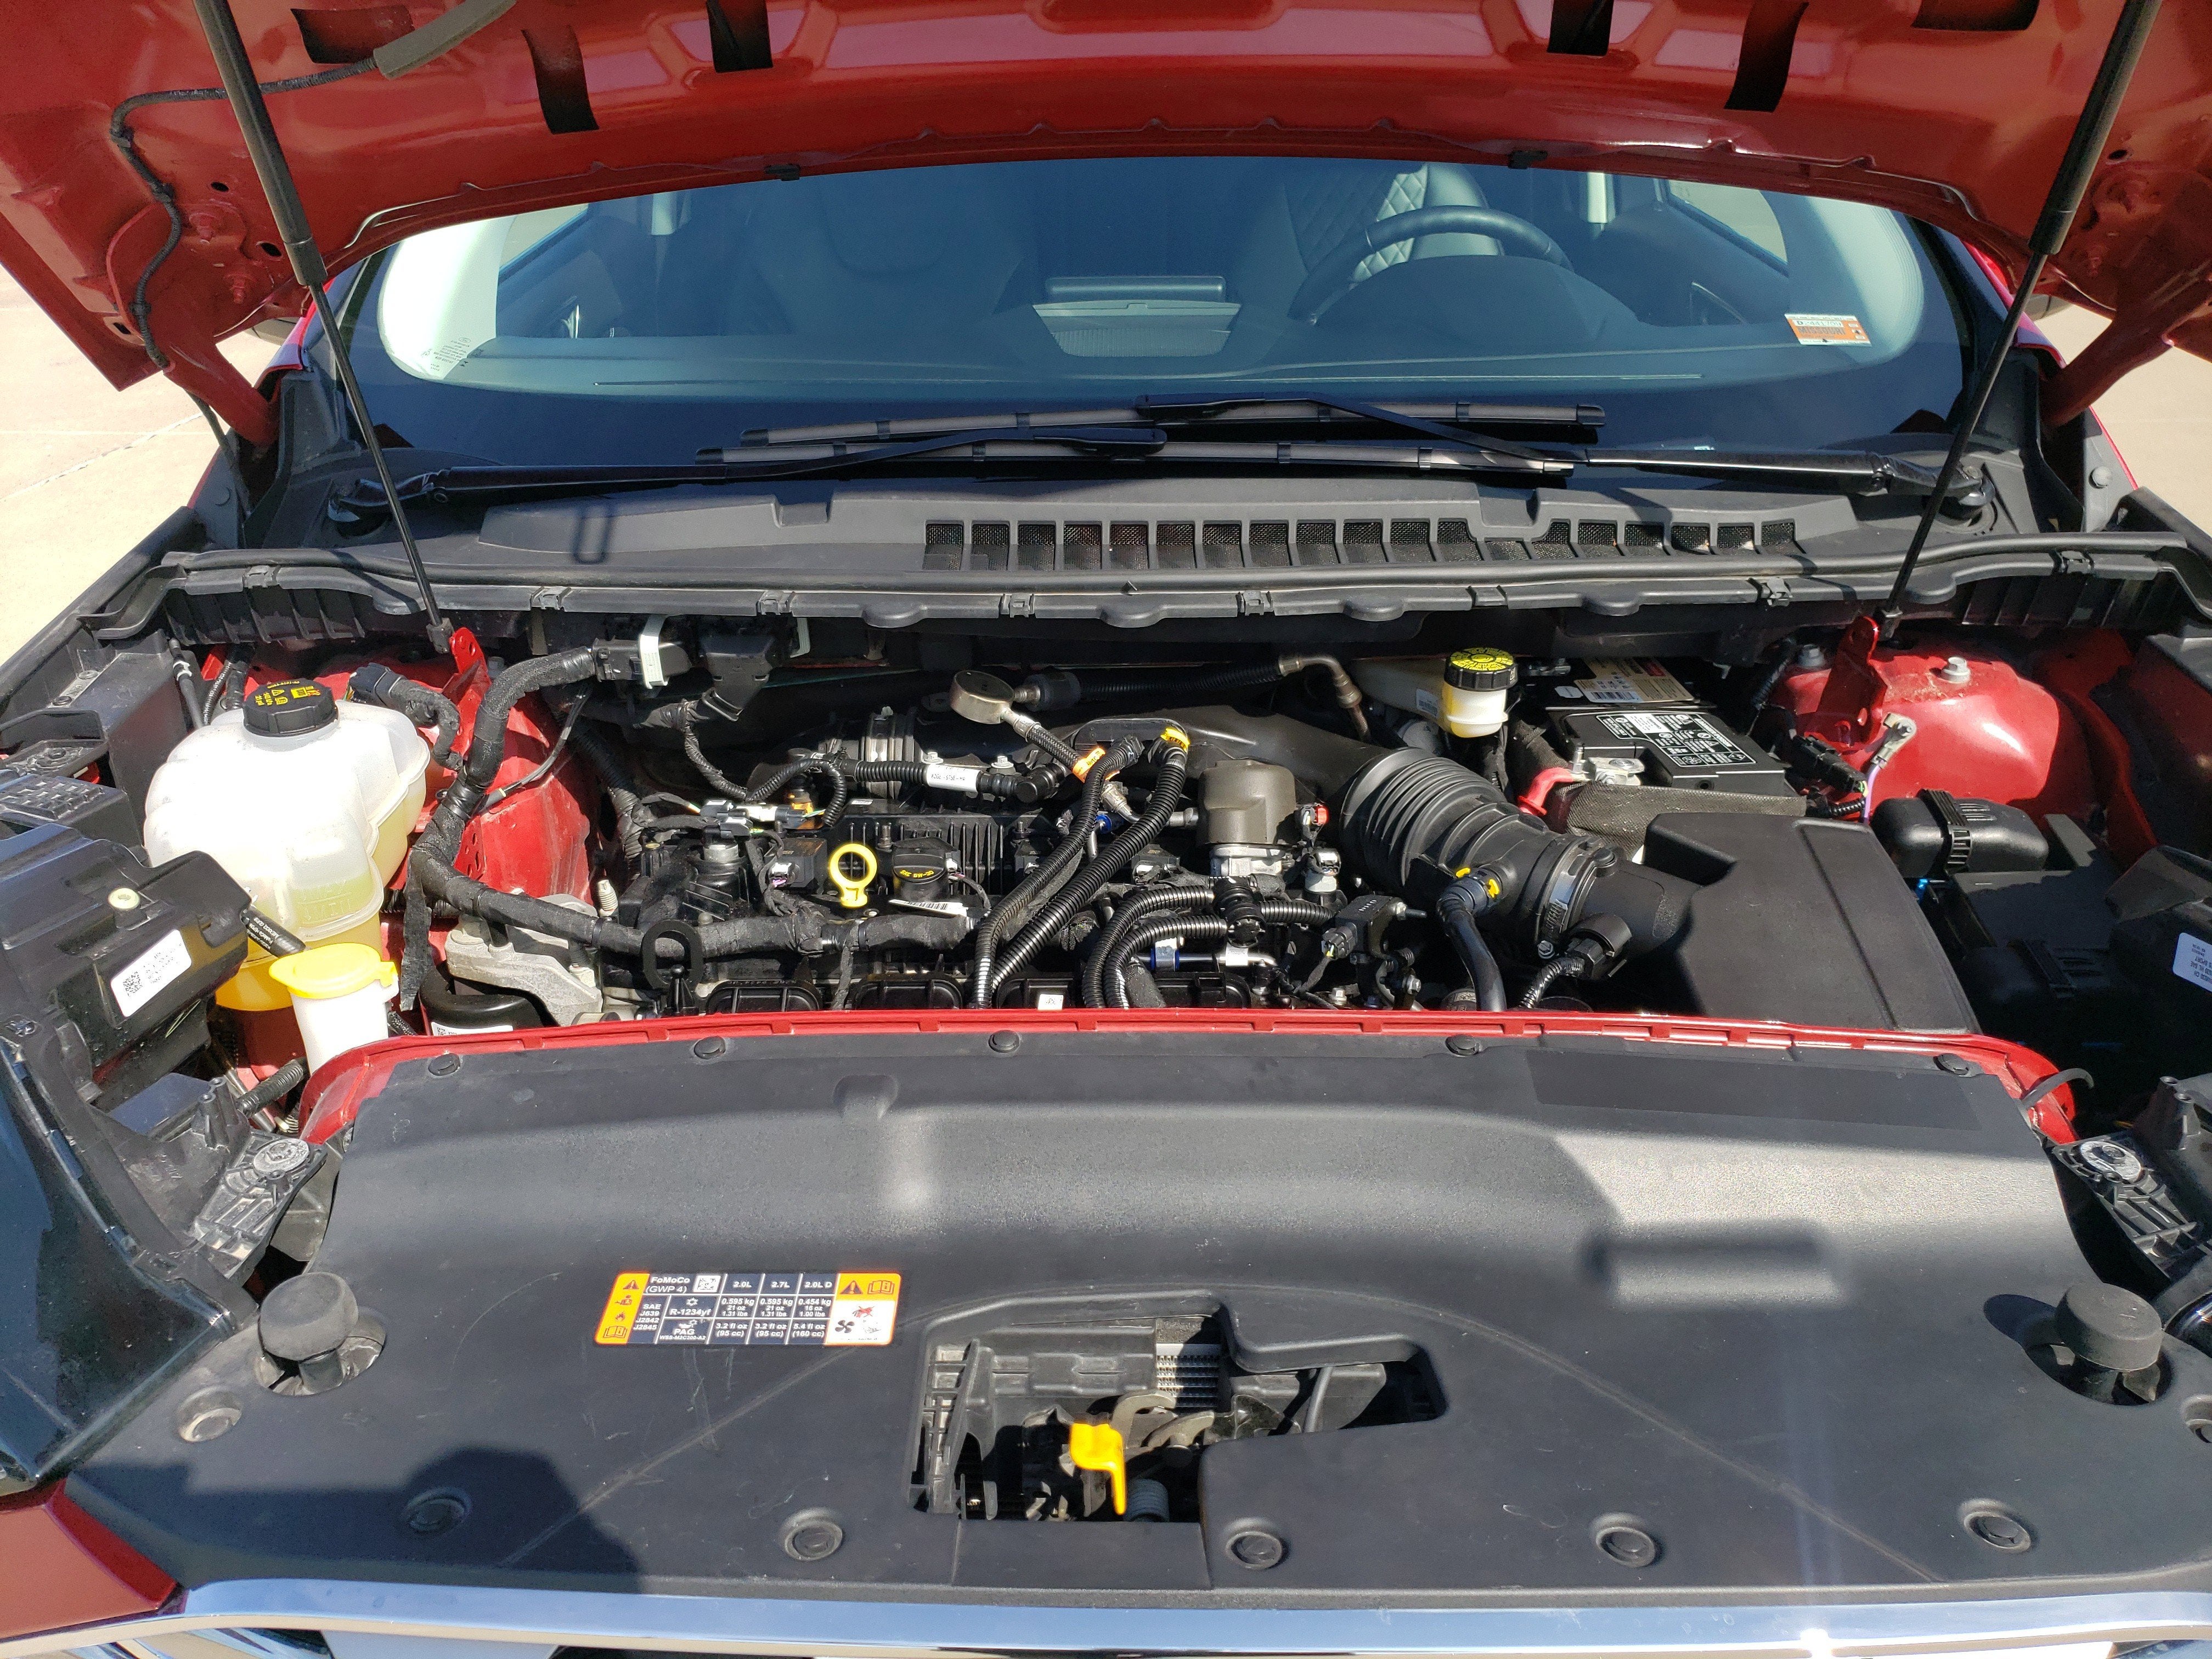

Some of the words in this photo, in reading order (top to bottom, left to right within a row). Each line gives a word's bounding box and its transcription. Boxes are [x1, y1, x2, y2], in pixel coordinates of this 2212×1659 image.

[1797, 326, 1847, 335] MISSOURI
[646, 1285, 675, 1294] (GWP
[676, 1285, 687, 1294] 4)
[744, 1298, 755, 1306] kg
[783, 1298, 793, 1306] kg
[821, 1298, 832, 1306] kg
[669, 1308, 712, 1317] R-1234yf
